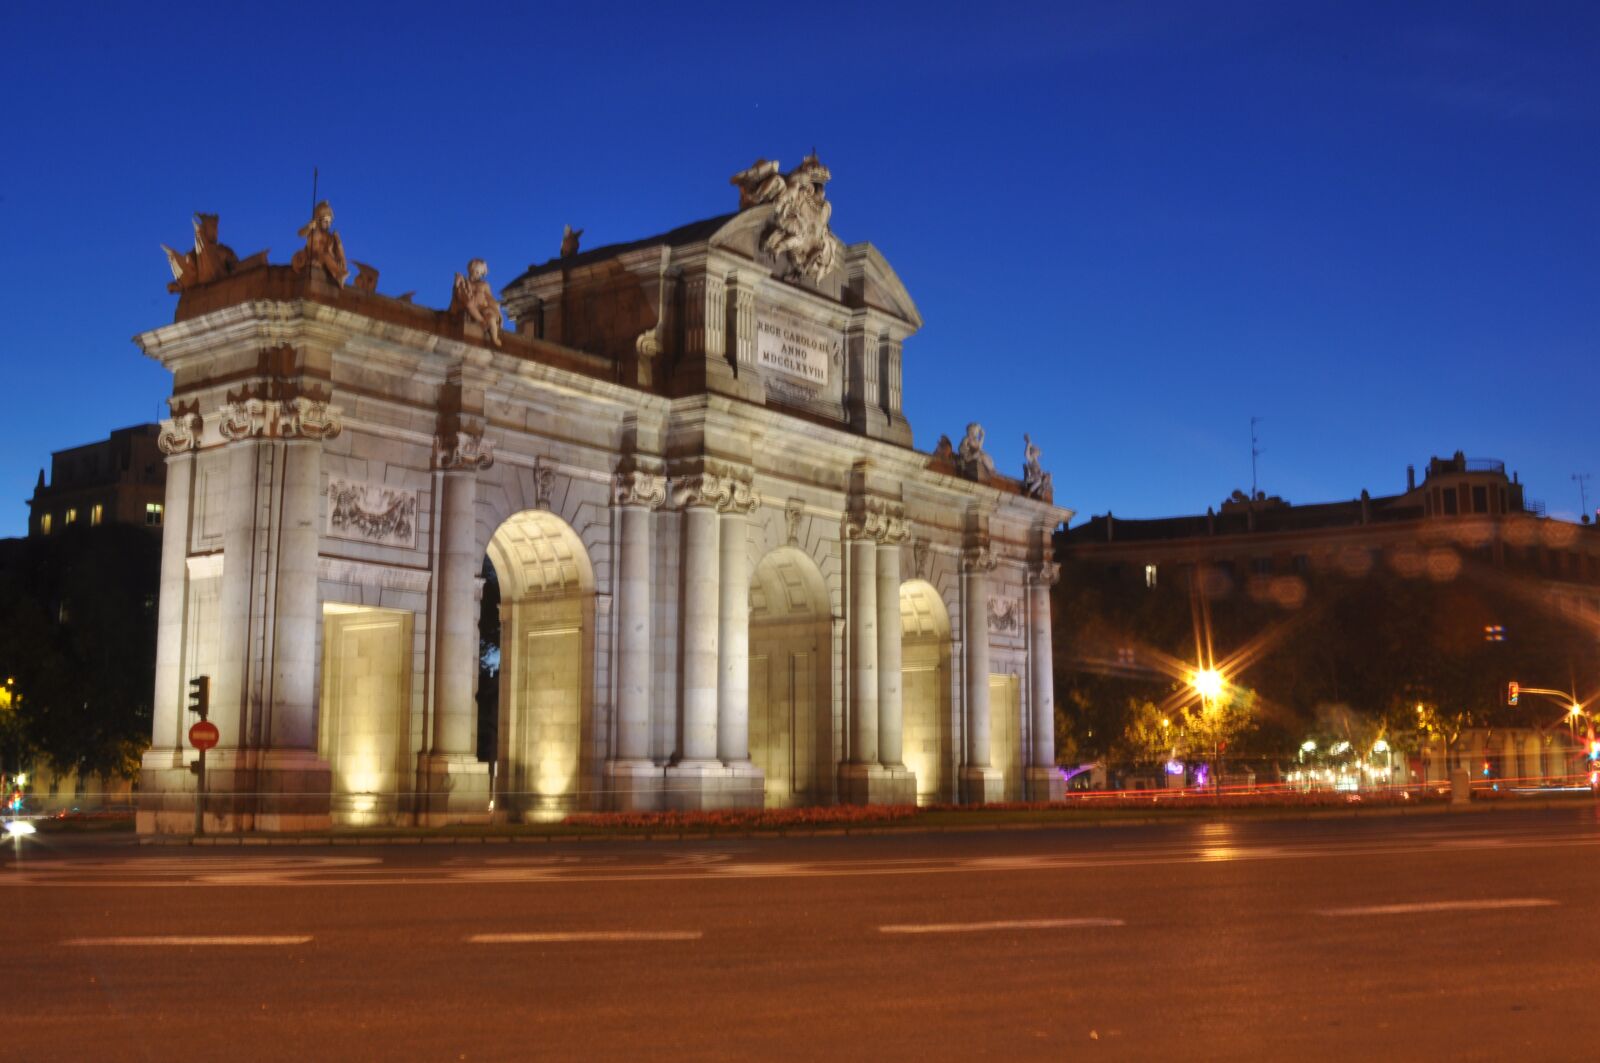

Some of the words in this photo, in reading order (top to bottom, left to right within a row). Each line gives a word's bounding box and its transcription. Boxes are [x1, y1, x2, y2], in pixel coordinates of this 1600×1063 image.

[757, 320, 781, 337] REGE
[783, 331, 817, 349] CAROLO
[763, 351, 824, 379] MDCCLXXVIII
[781, 343, 807, 359] ANNO
